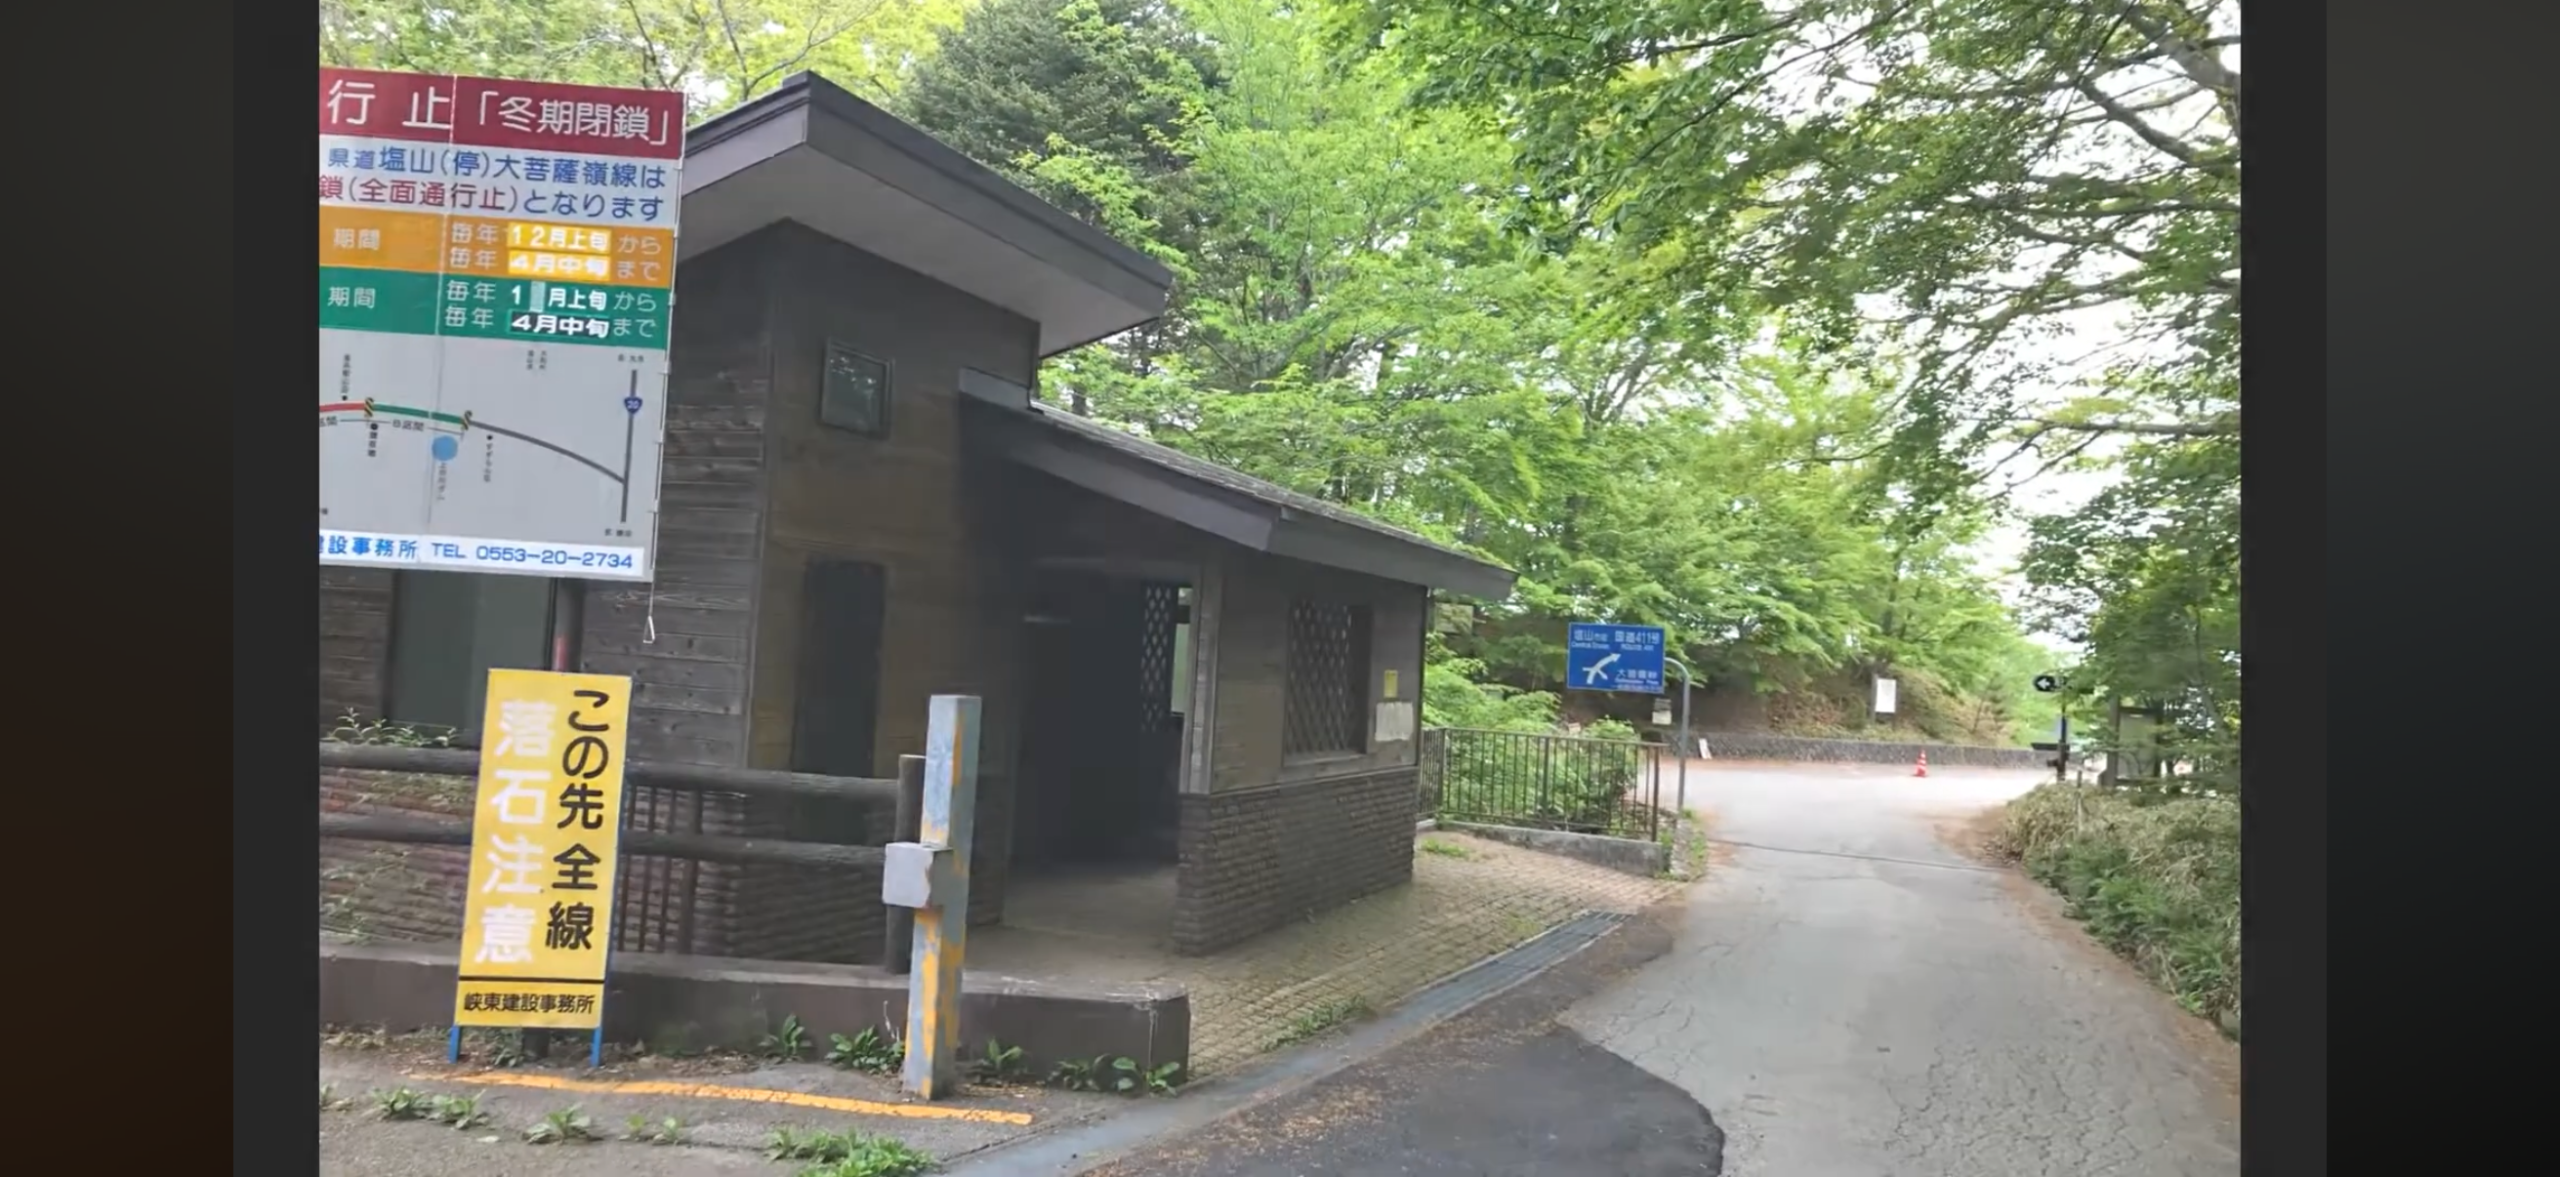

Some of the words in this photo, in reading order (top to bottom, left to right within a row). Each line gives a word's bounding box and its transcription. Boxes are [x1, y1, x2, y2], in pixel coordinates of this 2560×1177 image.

[333, 227, 381, 250] 期間
[327, 285, 376, 308] 期間
[431, 543, 467, 559] TEL
[476, 546, 633, 569] 0553-20-2734
[474, 700, 556, 964] 落石注意
[545, 690, 609, 950] この先全線
[464, 992, 595, 1014] 峡東建設事務所
